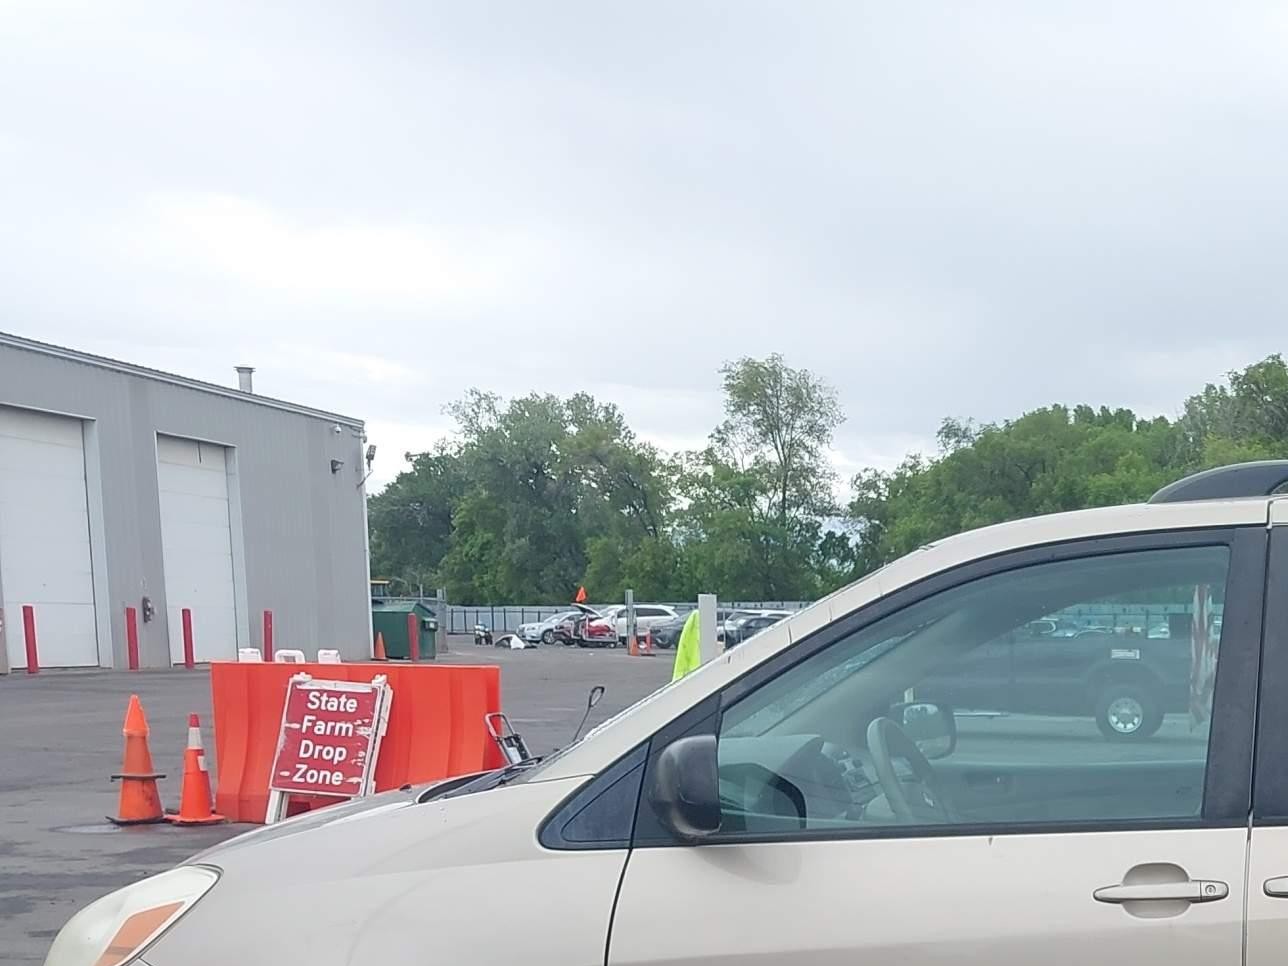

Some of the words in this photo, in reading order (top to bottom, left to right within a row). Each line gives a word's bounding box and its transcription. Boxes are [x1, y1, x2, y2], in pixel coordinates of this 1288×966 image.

[307, 691, 358, 712] State
[301, 715, 353, 737] Farm
[298, 739, 347, 765] Drop
[292, 764, 343, 785] Zone
